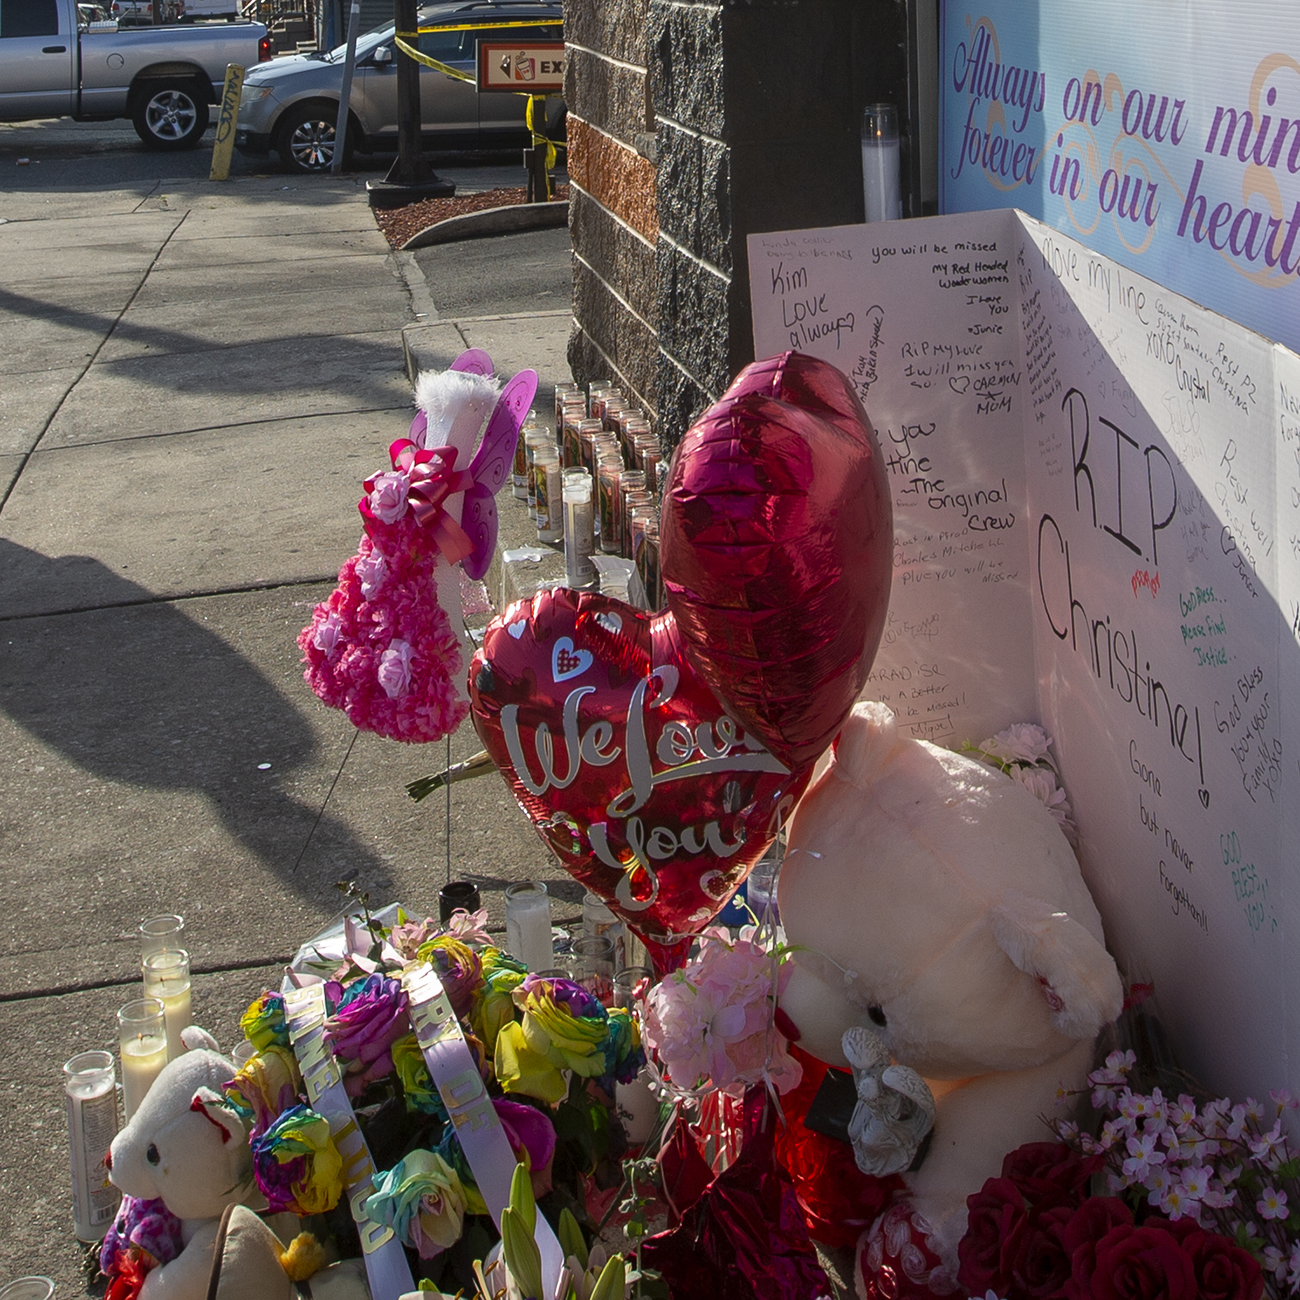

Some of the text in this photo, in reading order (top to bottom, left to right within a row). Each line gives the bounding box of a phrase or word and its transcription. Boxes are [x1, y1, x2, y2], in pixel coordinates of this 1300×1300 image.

[541, 61, 564, 74] EX
[953, 25, 1046, 133] Always
[1063, 76, 1105, 126] on
[1122, 89, 1188, 146] our
[951, 97, 1037, 185] forever
[1049, 134, 1083, 200] in
[1100, 168, 1160, 227] our
[902, 244, 927, 255] will
[933, 244, 949, 254] be
[955, 241, 998, 252] missed
[952, 262, 970, 274] Red
[771, 262, 808, 295] Kim
[917, 361, 950, 376] will
[957, 362, 991, 372] miss
[500, 665, 792, 818] We Lov
[1129, 739, 1162, 797] Gone
[1139, 794, 1194, 873] but never
[586, 816, 746, 911] You
